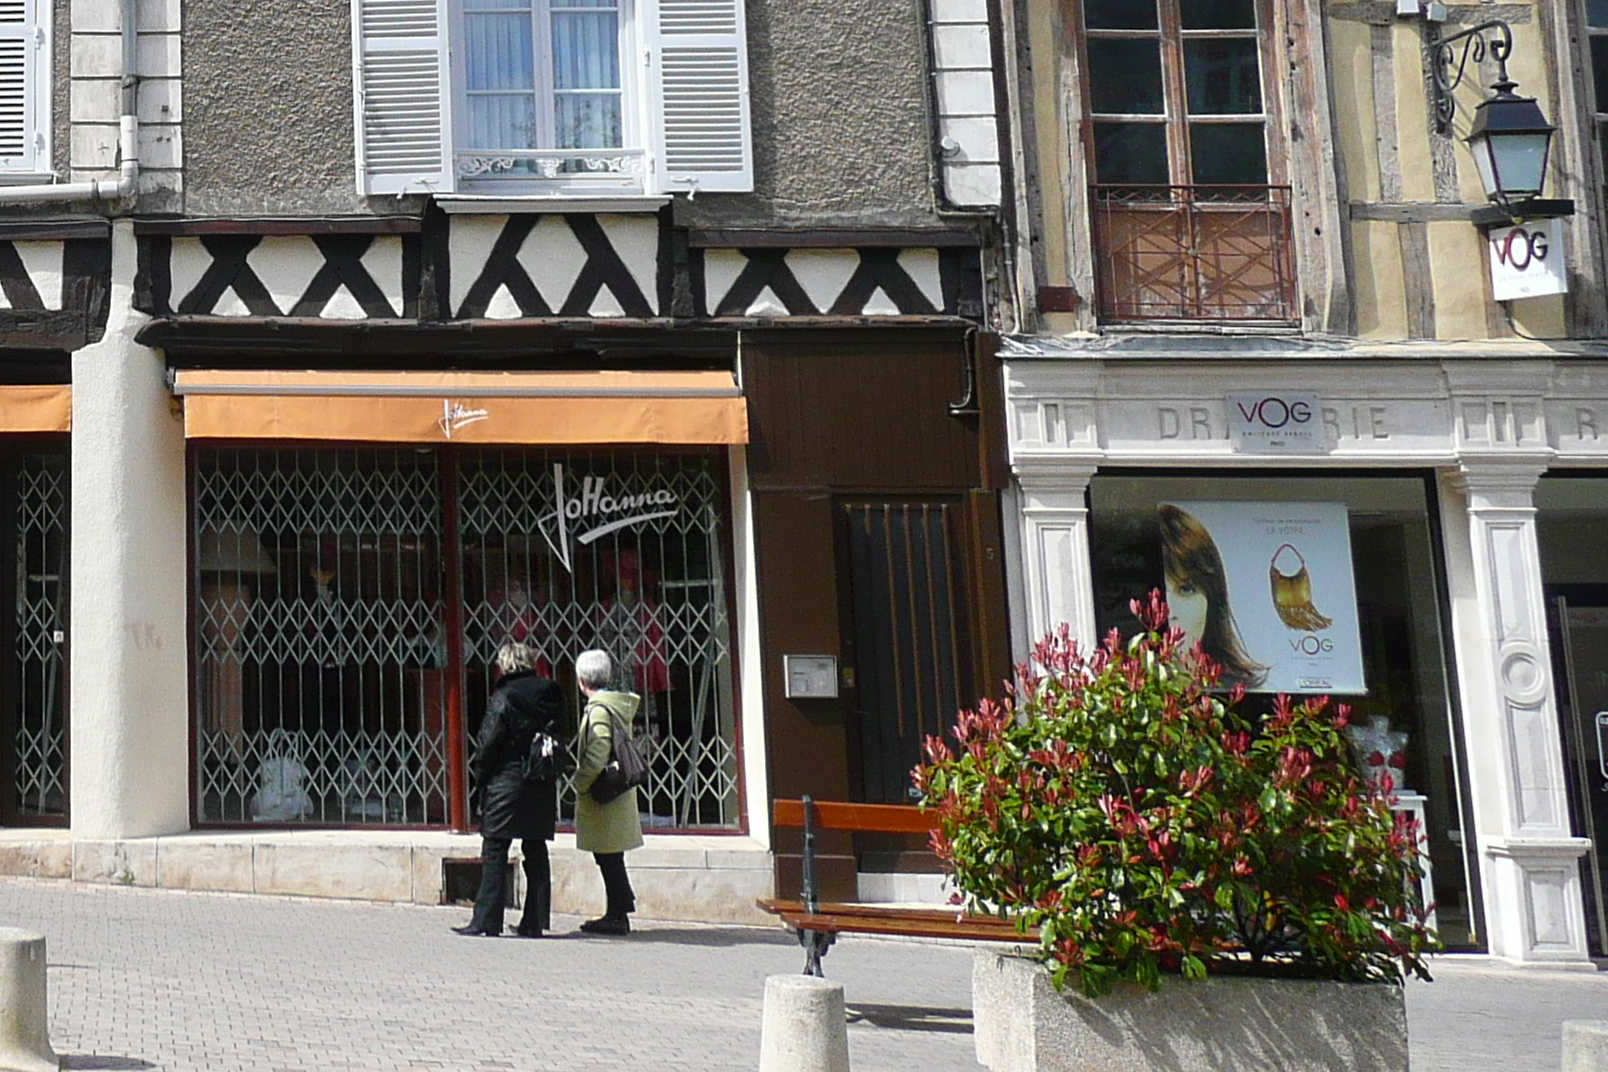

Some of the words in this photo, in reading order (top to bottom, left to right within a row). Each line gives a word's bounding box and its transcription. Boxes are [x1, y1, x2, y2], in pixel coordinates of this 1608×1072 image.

[1492, 227, 1549, 272] VOG
[1158, 407, 1390, 440] DRRIE
[1237, 397, 1312, 429] VOG
[1288, 635, 1334, 655] VOG
